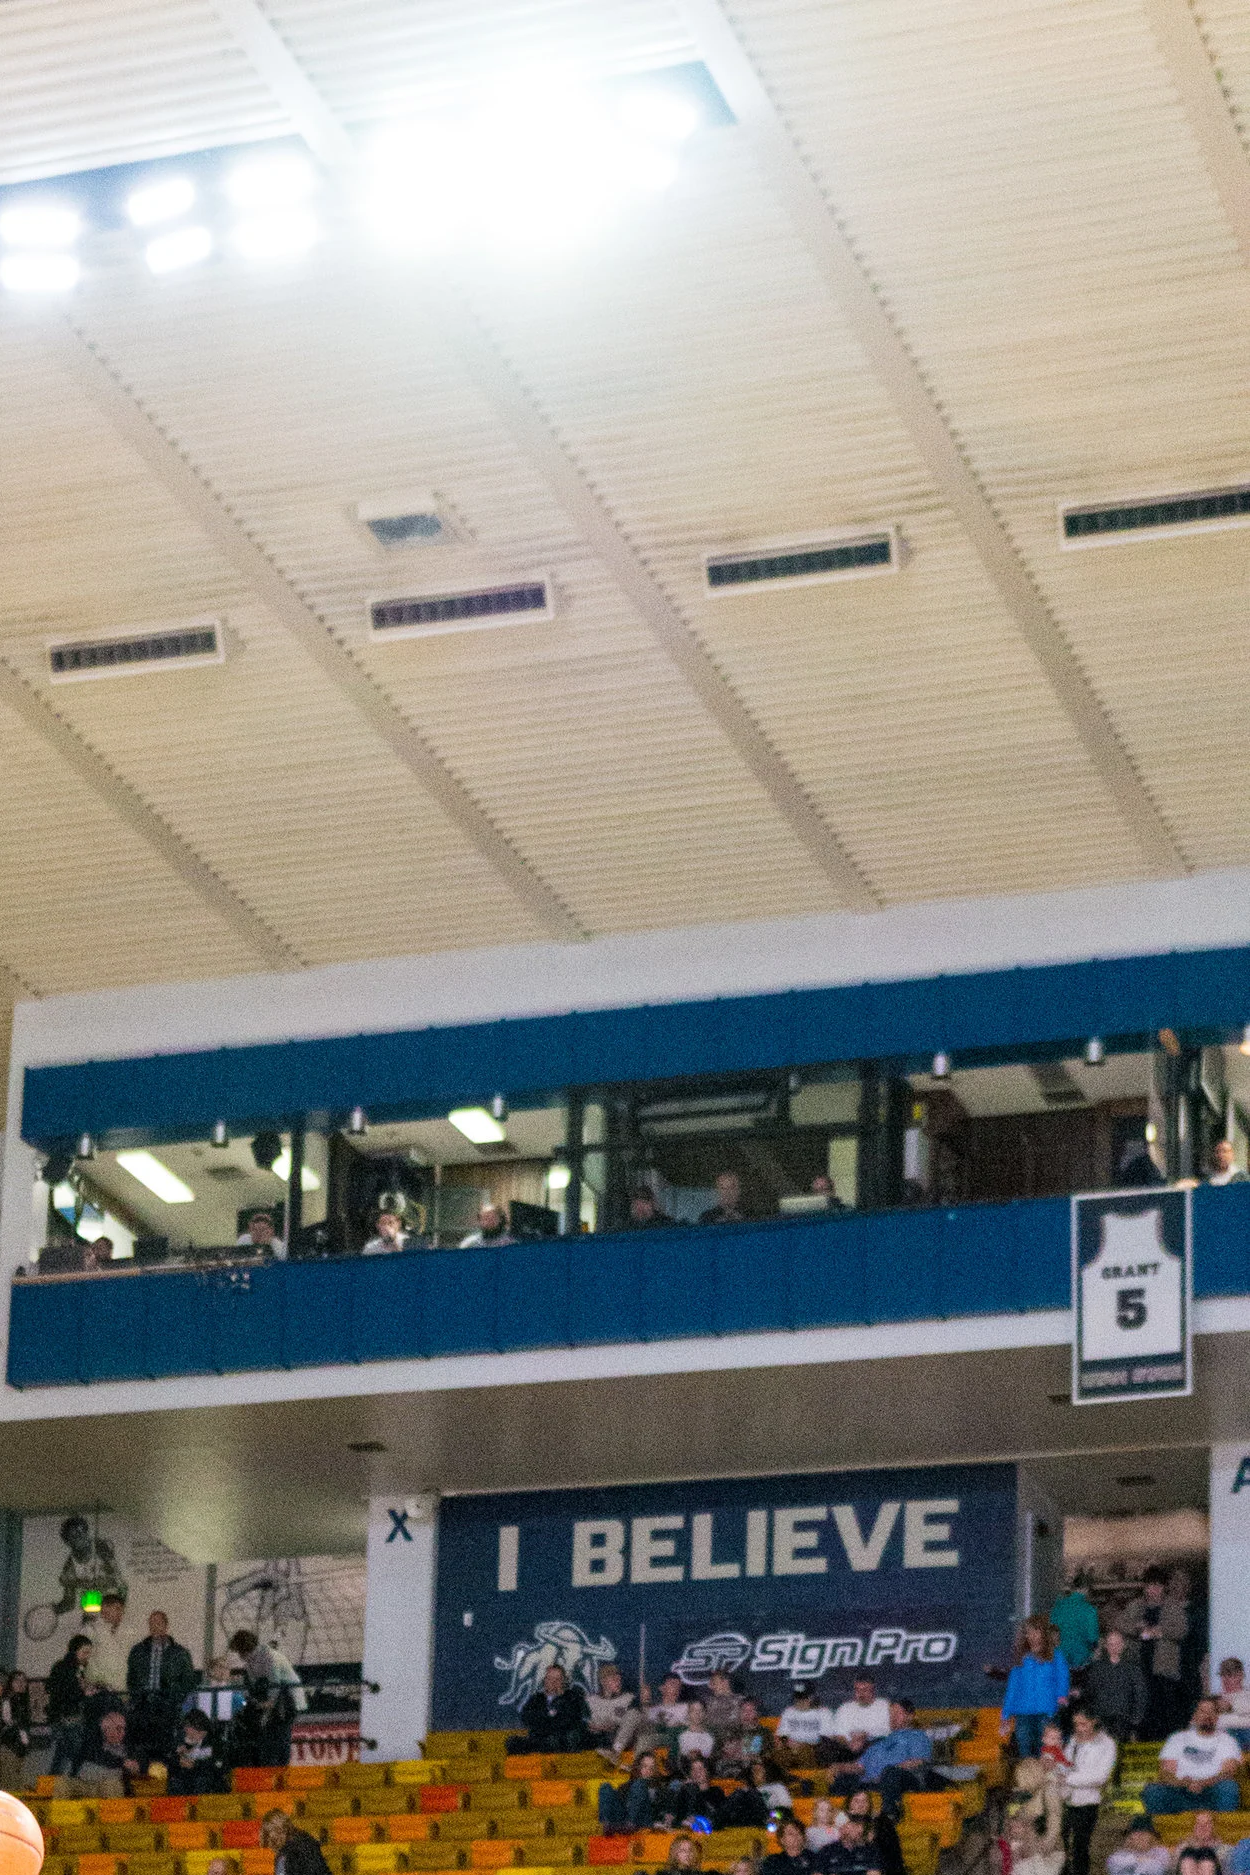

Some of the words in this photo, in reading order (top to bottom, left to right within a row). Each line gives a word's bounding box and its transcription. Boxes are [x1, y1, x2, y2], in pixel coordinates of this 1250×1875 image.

[1101, 1262, 1161, 1280] GRANT
[1116, 1287, 1148, 1331] 5
[386, 1509, 413, 1542] X
[497, 1526, 519, 1592] I
[571, 1499, 960, 1587] BELIEVE
[751, 1634, 860, 1679] Sign
[864, 1627, 958, 1667] Pro
